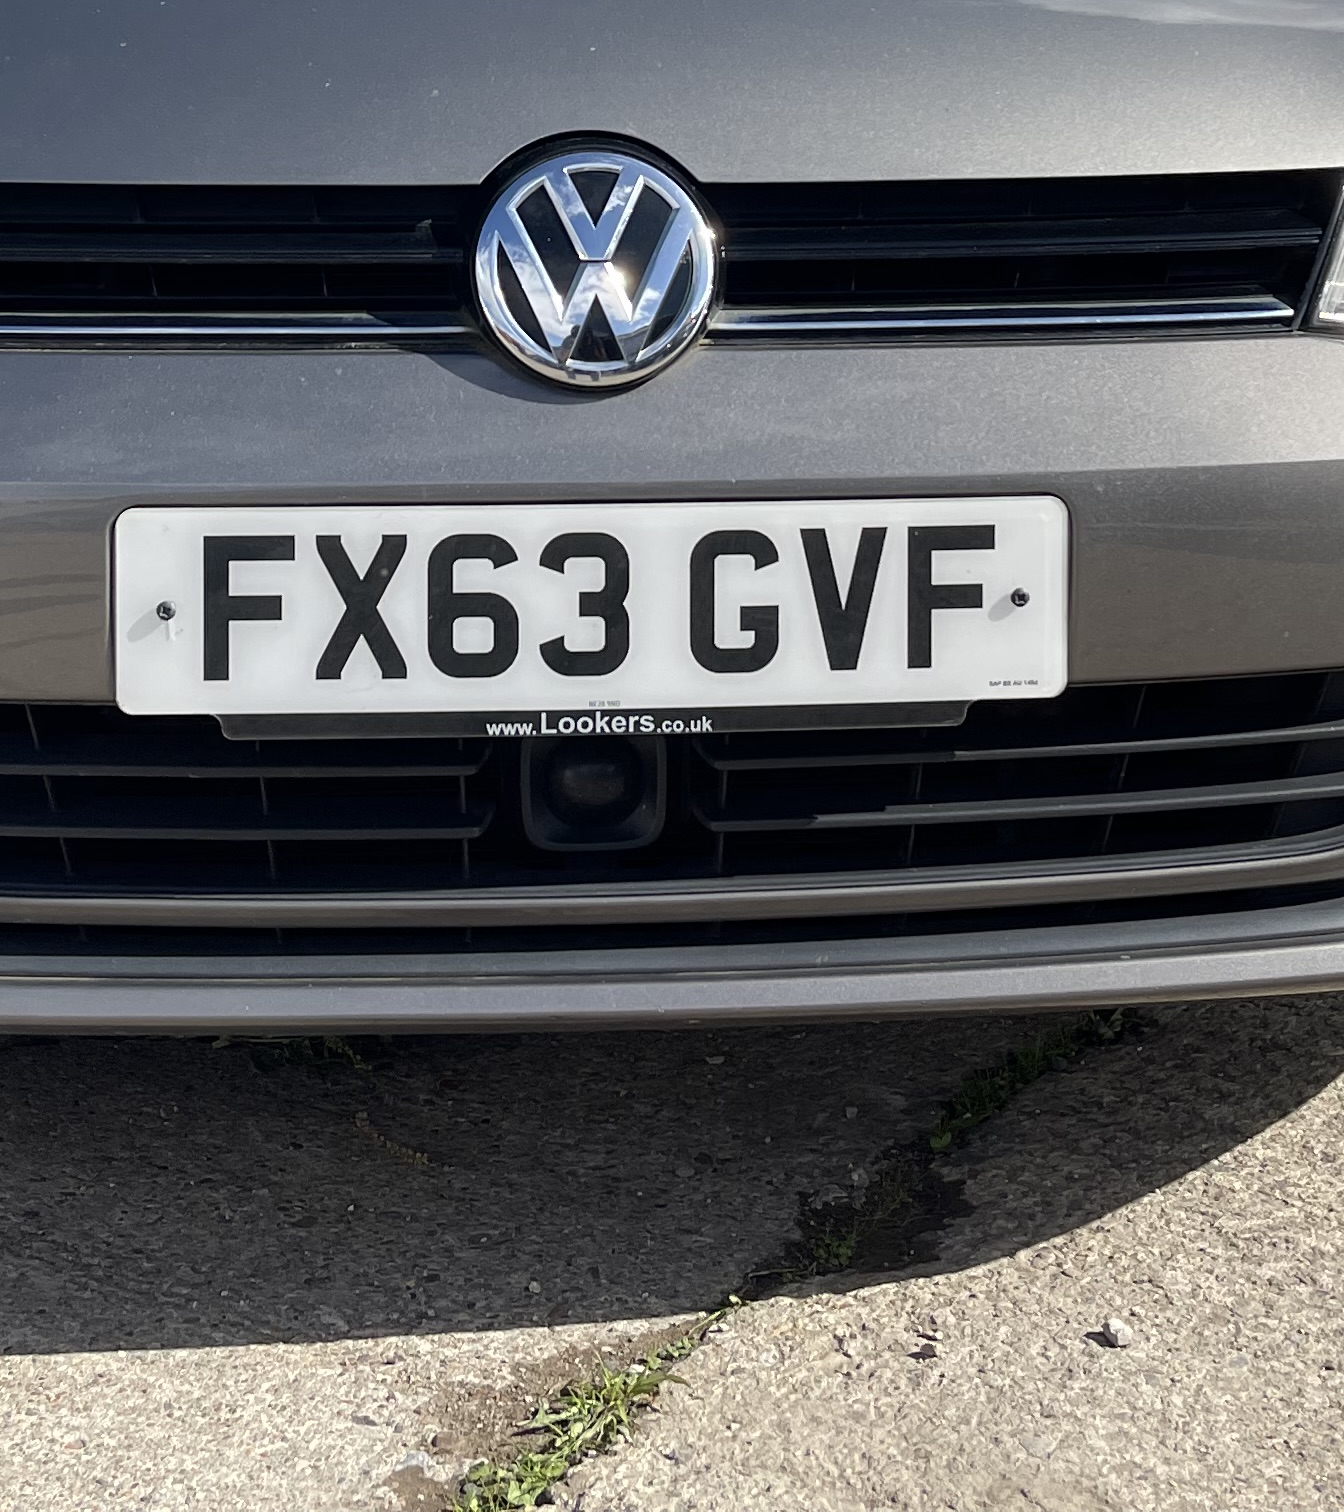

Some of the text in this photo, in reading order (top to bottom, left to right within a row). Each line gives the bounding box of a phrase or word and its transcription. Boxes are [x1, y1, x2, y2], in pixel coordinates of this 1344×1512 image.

[203, 524, 996, 681] FX63 GVF
[486, 711, 713, 736] www.Lookers.co.uk
